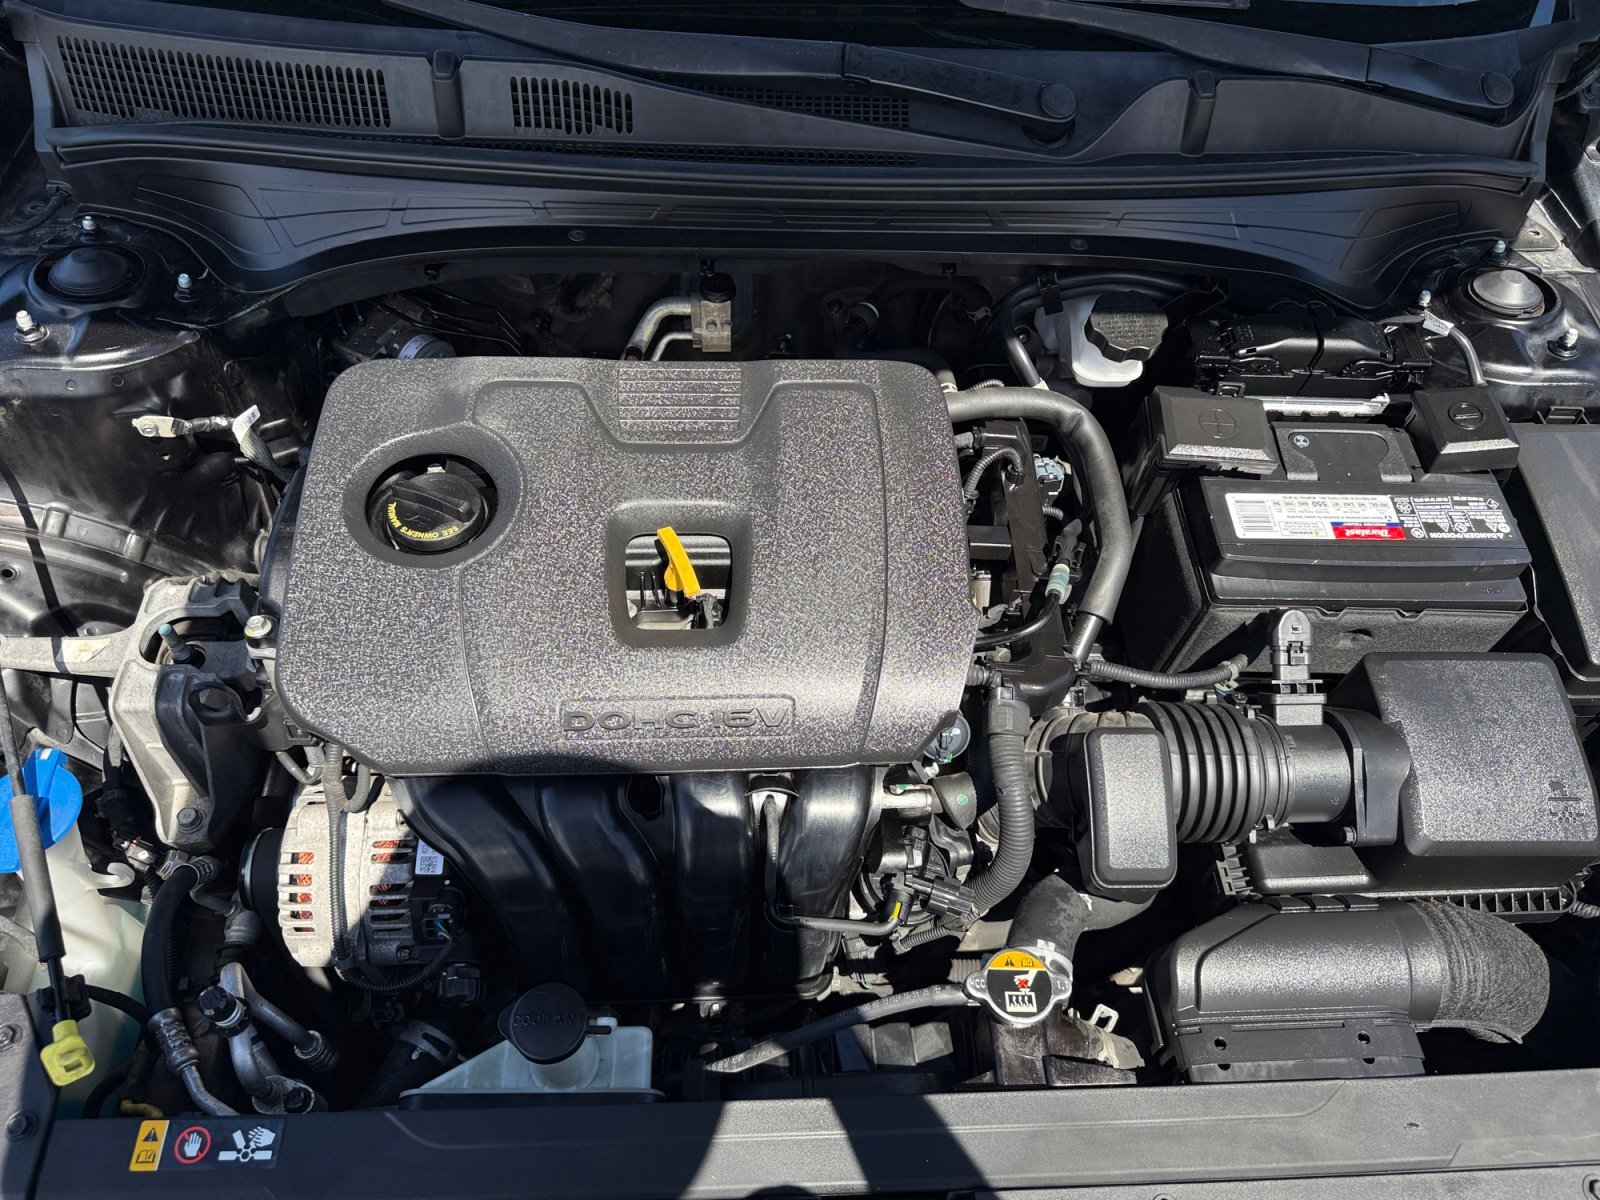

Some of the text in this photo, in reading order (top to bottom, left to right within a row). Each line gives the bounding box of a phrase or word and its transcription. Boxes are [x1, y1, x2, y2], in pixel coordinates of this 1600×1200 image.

[388, 502, 459, 539] SEE OWNER'S MANUAL
[1344, 529, 1392, 538] Duralast
[562, 706, 788, 732] DOHC 16V
[1056, 980, 1070, 990] 1.1
[512, 1013, 584, 1026] COOLANT
